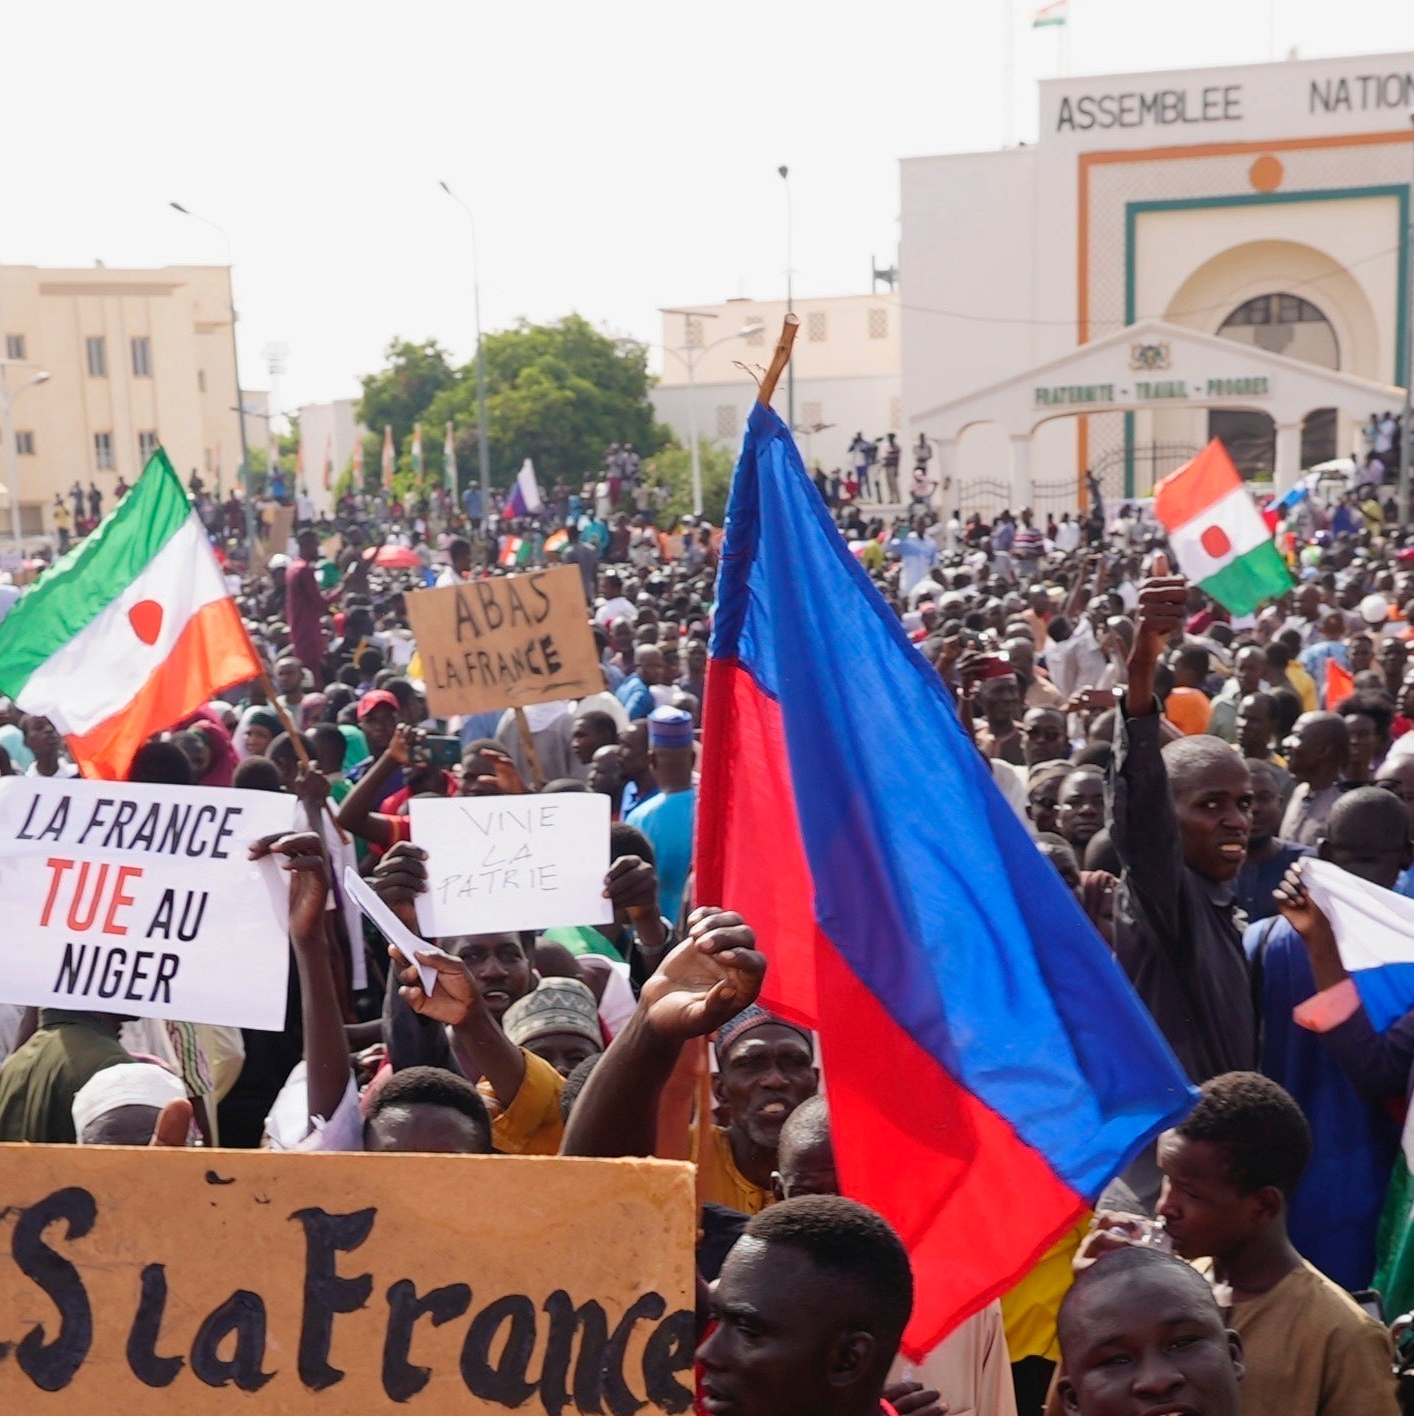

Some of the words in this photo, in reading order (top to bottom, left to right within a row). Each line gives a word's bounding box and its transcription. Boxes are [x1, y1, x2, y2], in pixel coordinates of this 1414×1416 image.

[1057, 85, 1243, 133] ASSEMBLEE
[454, 572, 551, 643] ABAS
[464, 634, 563, 688] FRANCE
[15, 793, 73, 842] LA
[77, 798, 243, 860] FRANCE
[482, 843, 533, 868] LA
[40, 857, 144, 936] TUE
[146, 887, 209, 942] AU
[437, 864, 559, 905] PATRIE
[53, 943, 180, 1004] NIGER
